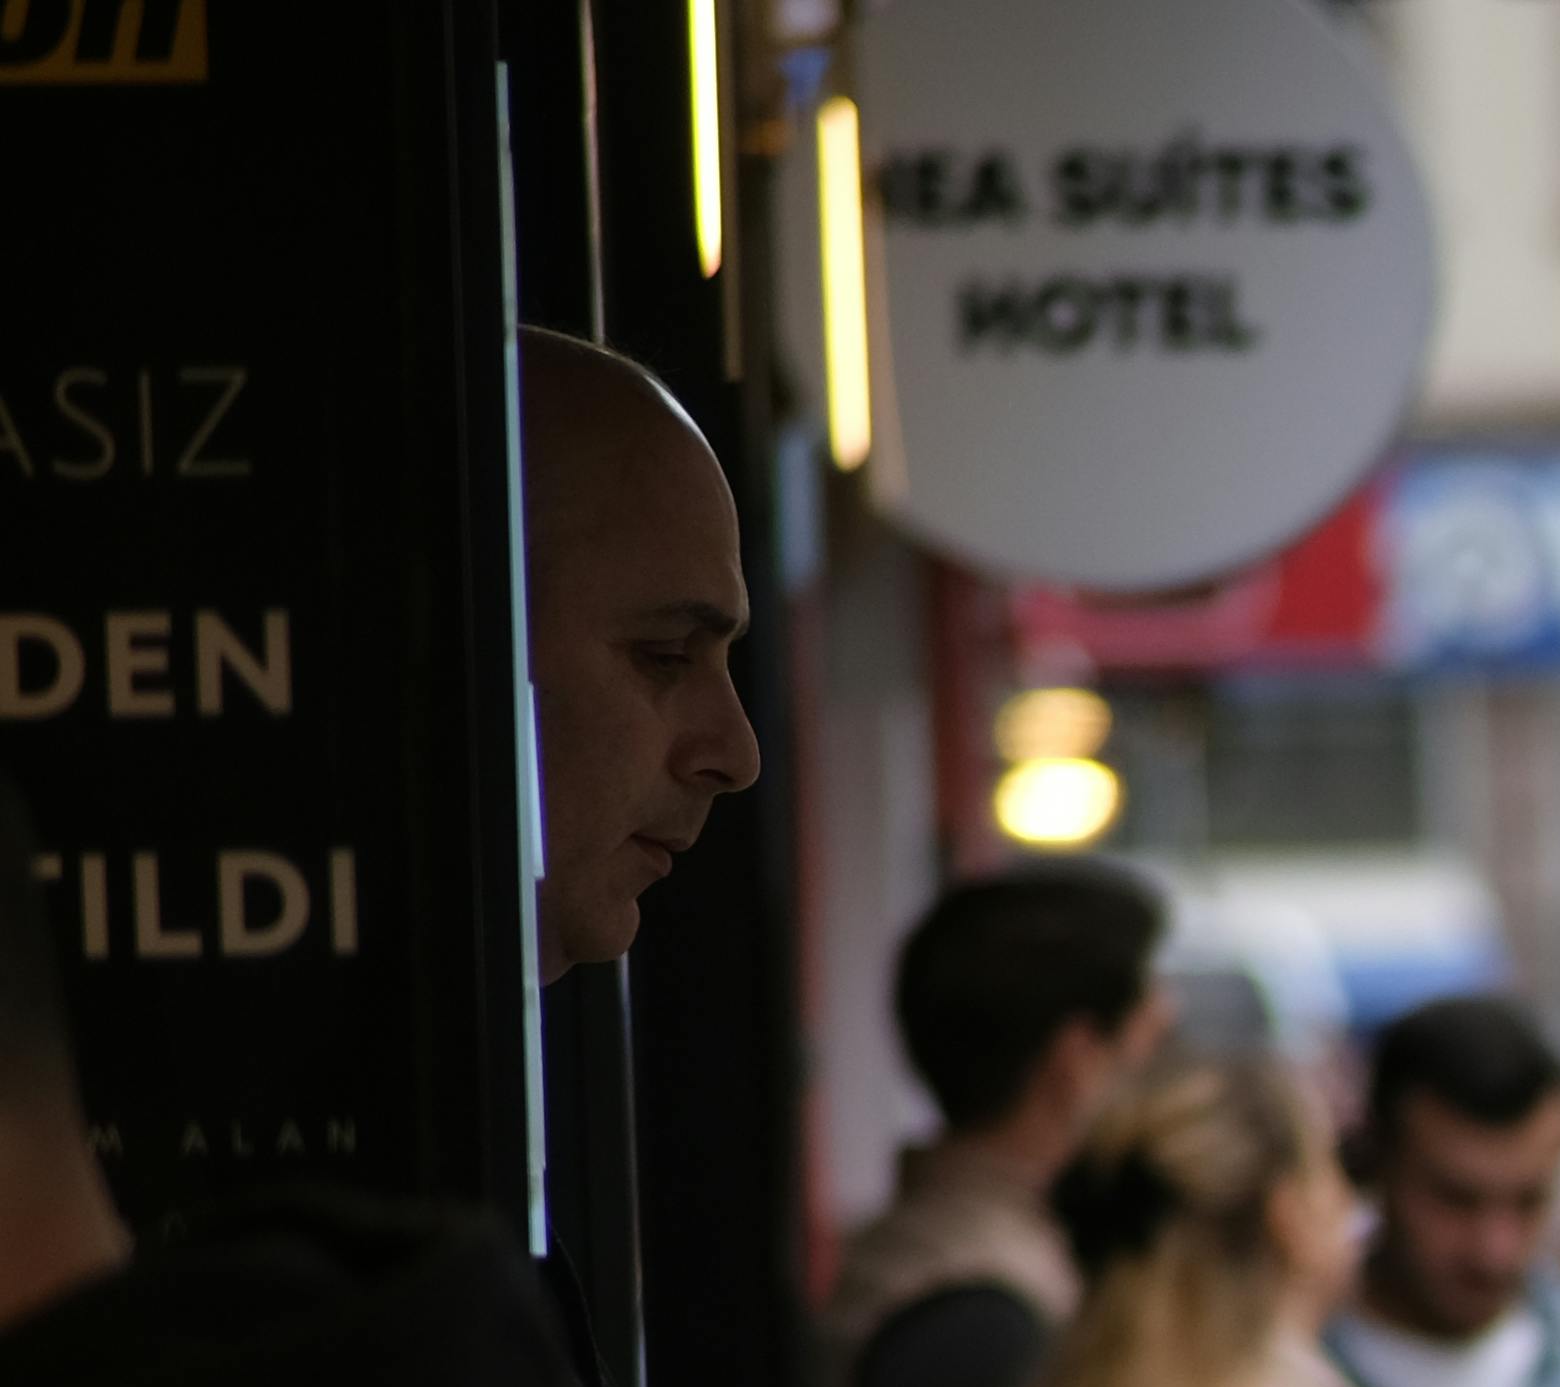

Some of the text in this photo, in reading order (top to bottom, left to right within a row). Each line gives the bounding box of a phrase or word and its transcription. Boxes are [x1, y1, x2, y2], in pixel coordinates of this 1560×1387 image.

[955, 272, 1257, 354] HOTEL
[0, 606, 294, 724] DEN
[28, 846, 361, 962] ILDI
[180, 1116, 359, 1159] ALAN
